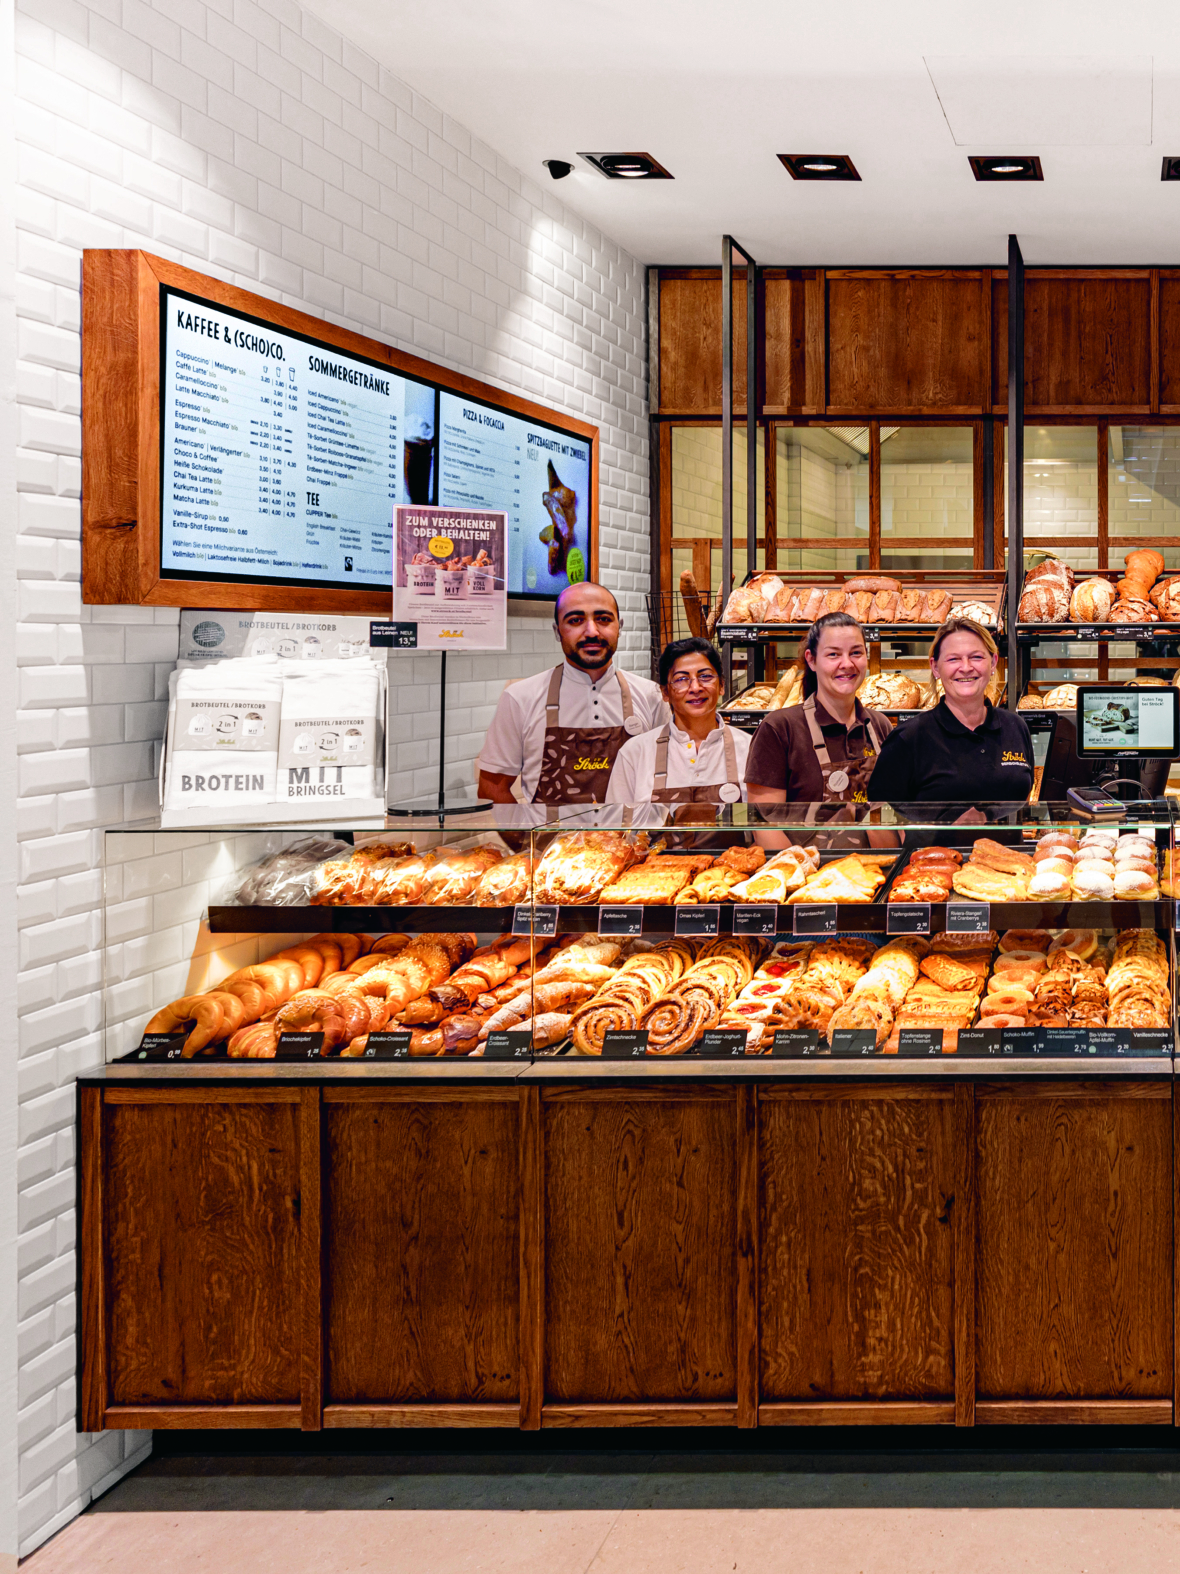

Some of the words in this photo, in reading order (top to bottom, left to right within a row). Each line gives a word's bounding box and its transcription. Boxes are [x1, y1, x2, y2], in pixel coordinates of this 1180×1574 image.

[177, 309, 220, 340] KAFFEE
[224, 326, 231, 344] &
[234, 329, 286, 362] (SCHO)CO.
[308, 355, 390, 396] SOMMERGETRÄNKE
[175, 384, 190, 394] Latte
[174, 410, 201, 423] Espresso
[463, 408, 477, 423] PIZZA
[483, 415, 505, 431] FOCACCIA
[527, 433, 560, 453] SPITZBAGUETTE
[561, 444, 569, 455] MIT
[174, 448, 192, 458] Choco
[174, 459, 190, 469] Heiße
[174, 471, 187, 479] Chai
[188, 473, 198, 481] Tea
[199, 475, 213, 484] Latte
[173, 483, 198, 493] Kurkuma
[199, 486, 214, 494] Latte
[173, 494, 194, 503] Matcha
[195, 497, 210, 505] Latte
[306, 491, 320, 506] TEE
[173, 509, 209, 520] Vanille-Sirup
[172, 520, 203, 530] Extra-Shot
[204, 524, 228, 533] Espresso
[405, 516, 428, 526] ZUM
[432, 517, 496, 530] VERSCHENKEN
[413, 528, 438, 538] ODER
[441, 529, 490, 541] BEHALTEN!
[172, 550, 196, 559] Vollmilch
[219, 720, 223, 728] 2
[321, 738, 325, 746] 2
[573, 757, 610, 771] Ströck
[288, 766, 344, 785] MIT
[181, 774, 265, 792] BROTEIN
[288, 785, 346, 797] BRINGSEL
